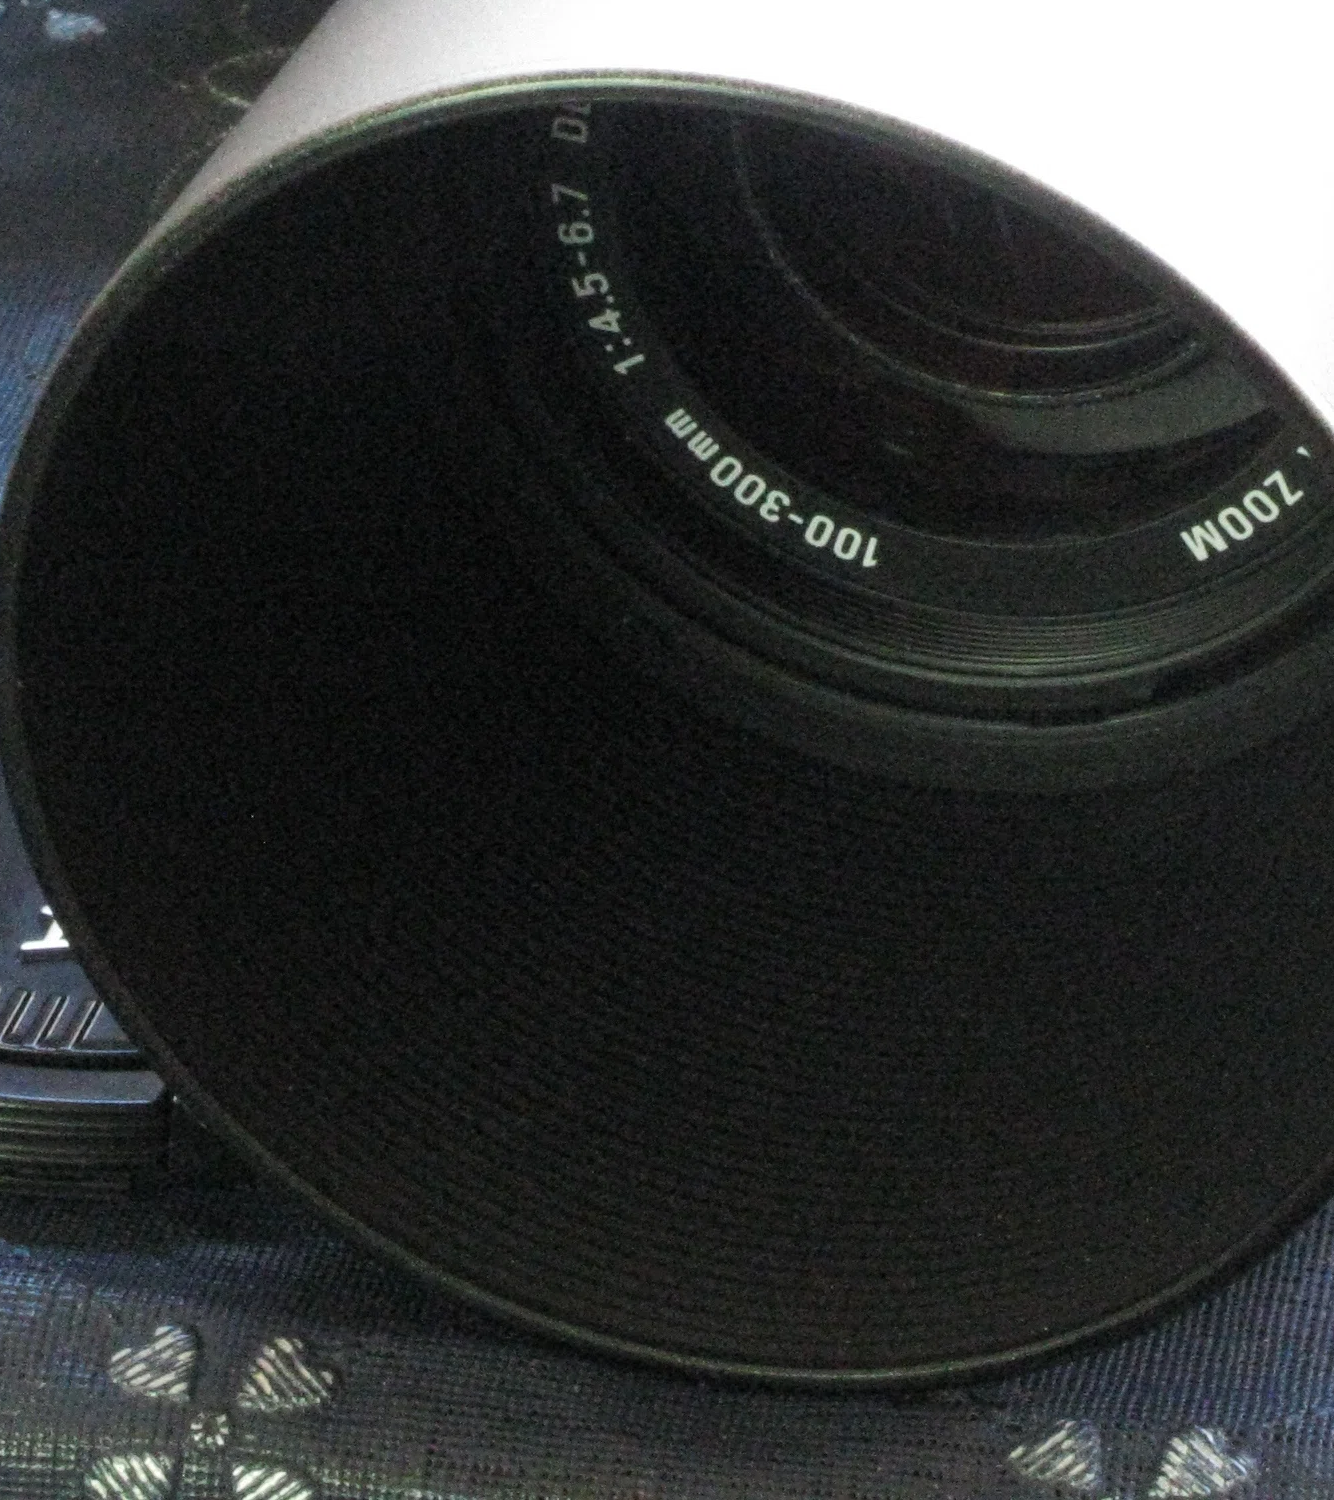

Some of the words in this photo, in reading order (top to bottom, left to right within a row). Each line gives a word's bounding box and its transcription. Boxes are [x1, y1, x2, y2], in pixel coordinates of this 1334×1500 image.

[551, 184, 646, 376] 1:4.5-6.7
[664, 406, 879, 568] 100-300mm
[1180, 469, 1305, 563] ZOOM
